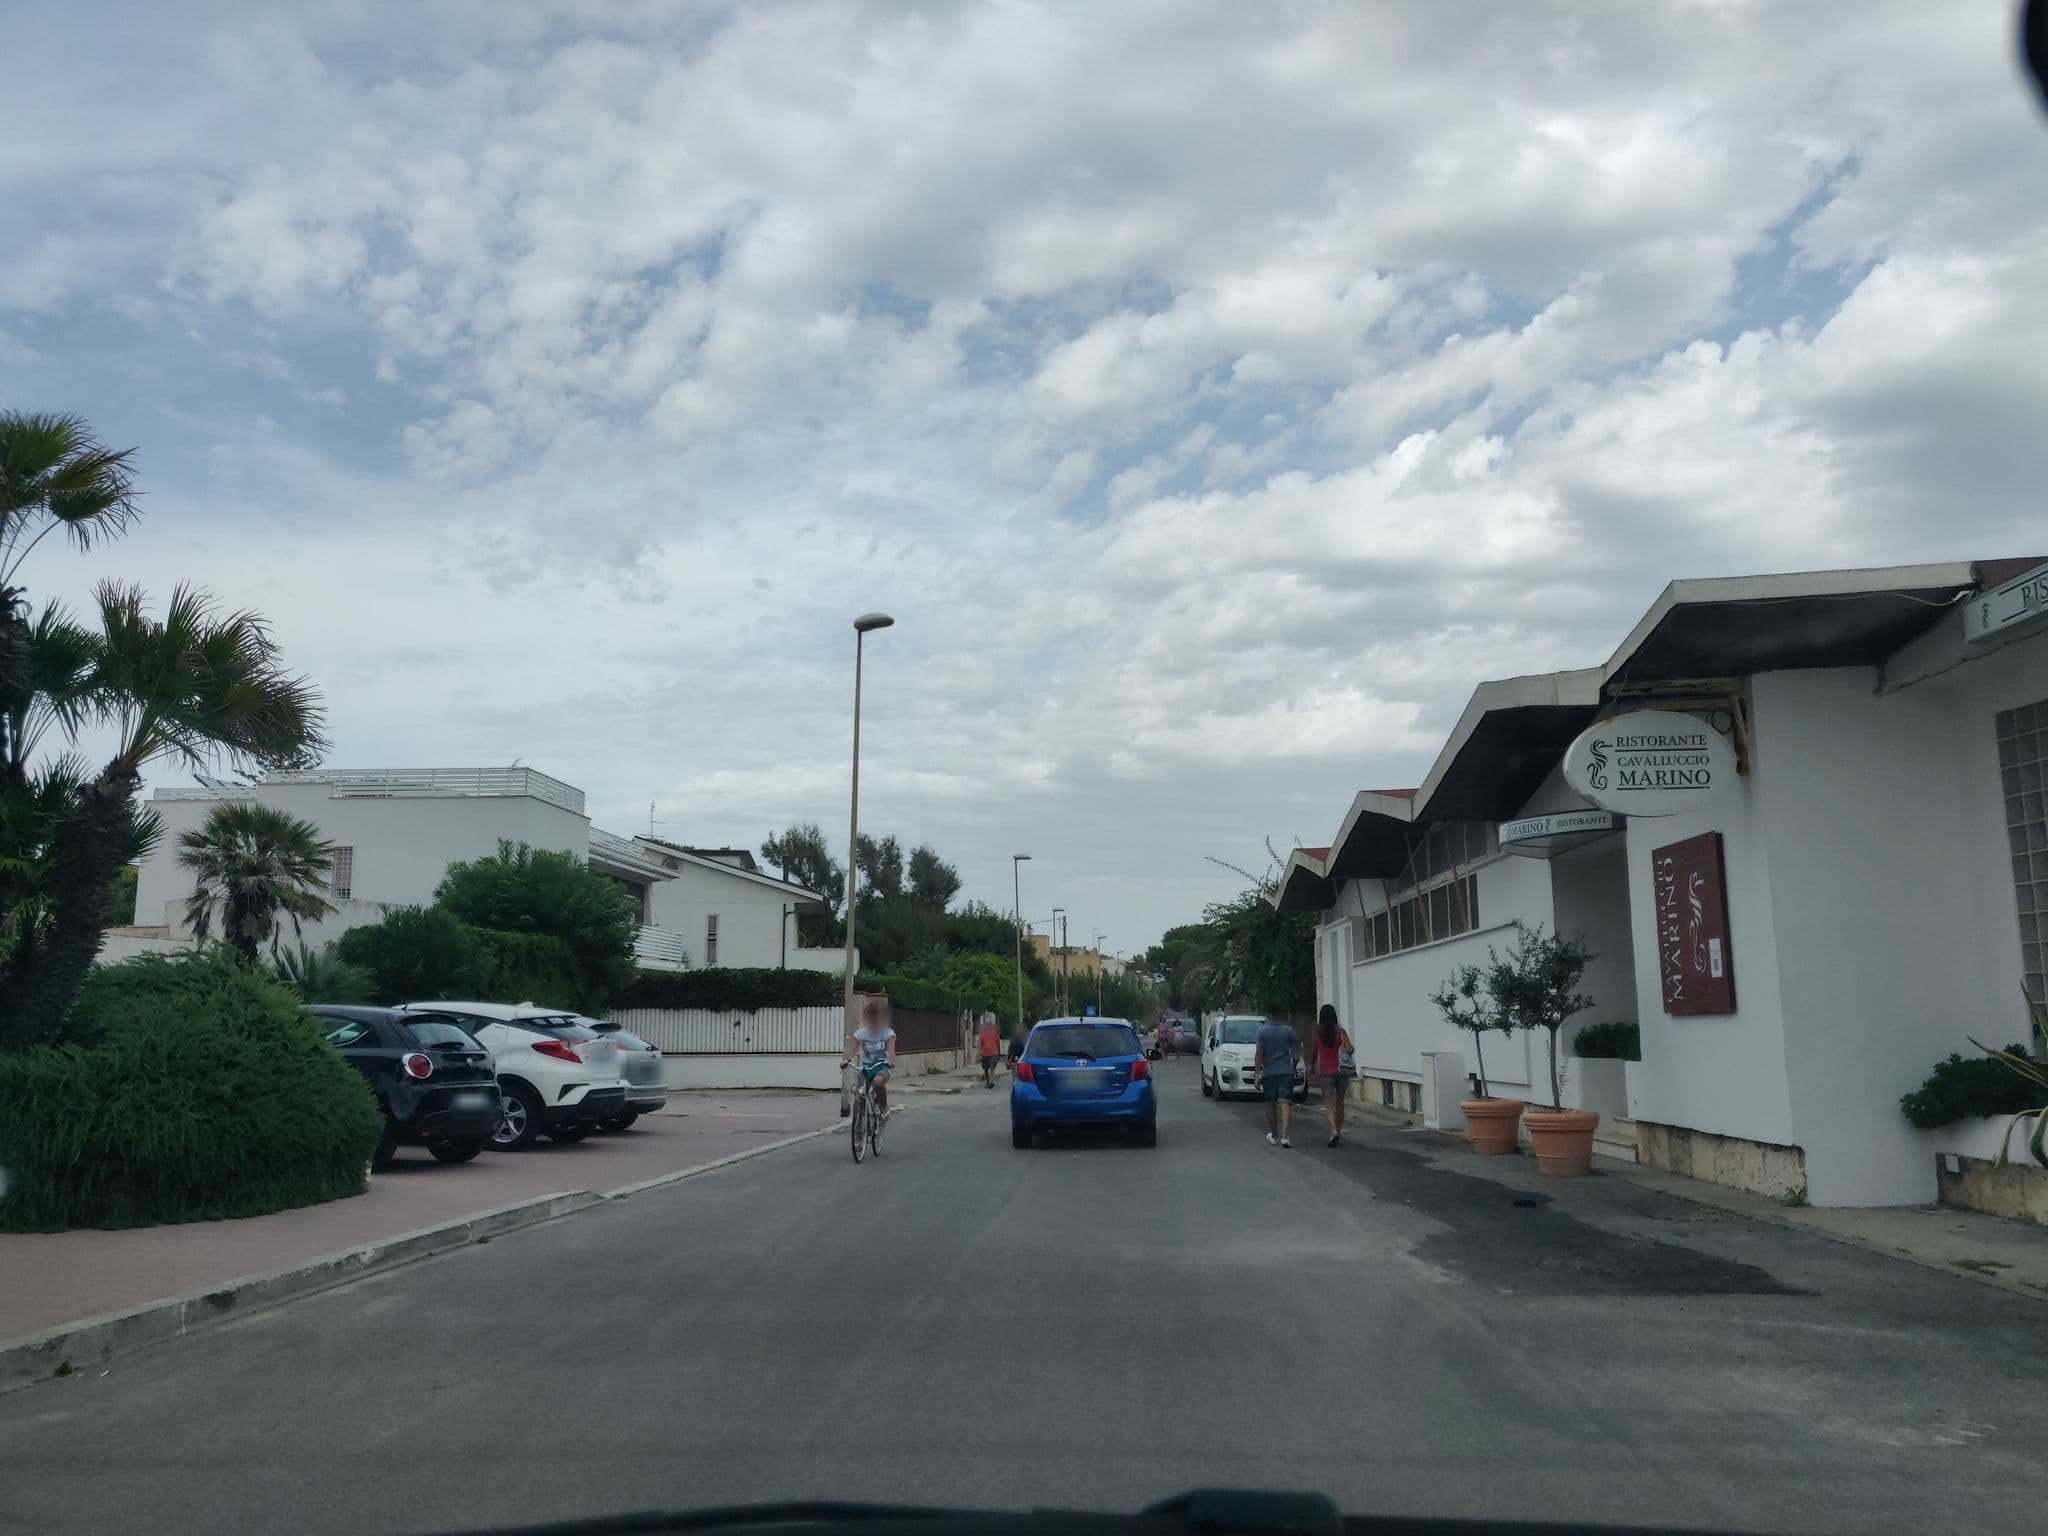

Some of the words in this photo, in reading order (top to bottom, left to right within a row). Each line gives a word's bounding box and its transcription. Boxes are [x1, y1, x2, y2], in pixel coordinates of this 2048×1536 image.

[1615, 734, 1708, 748] RISTORANTE
[1617, 755, 1710, 767] CAVALLUCCIO
[1618, 769, 1711, 786] MARINO
[1512, 821, 1544, 836] MARINO
[1556, 815, 1609, 828] RISTORANTE
[1664, 857, 1684, 1000] MARINO
